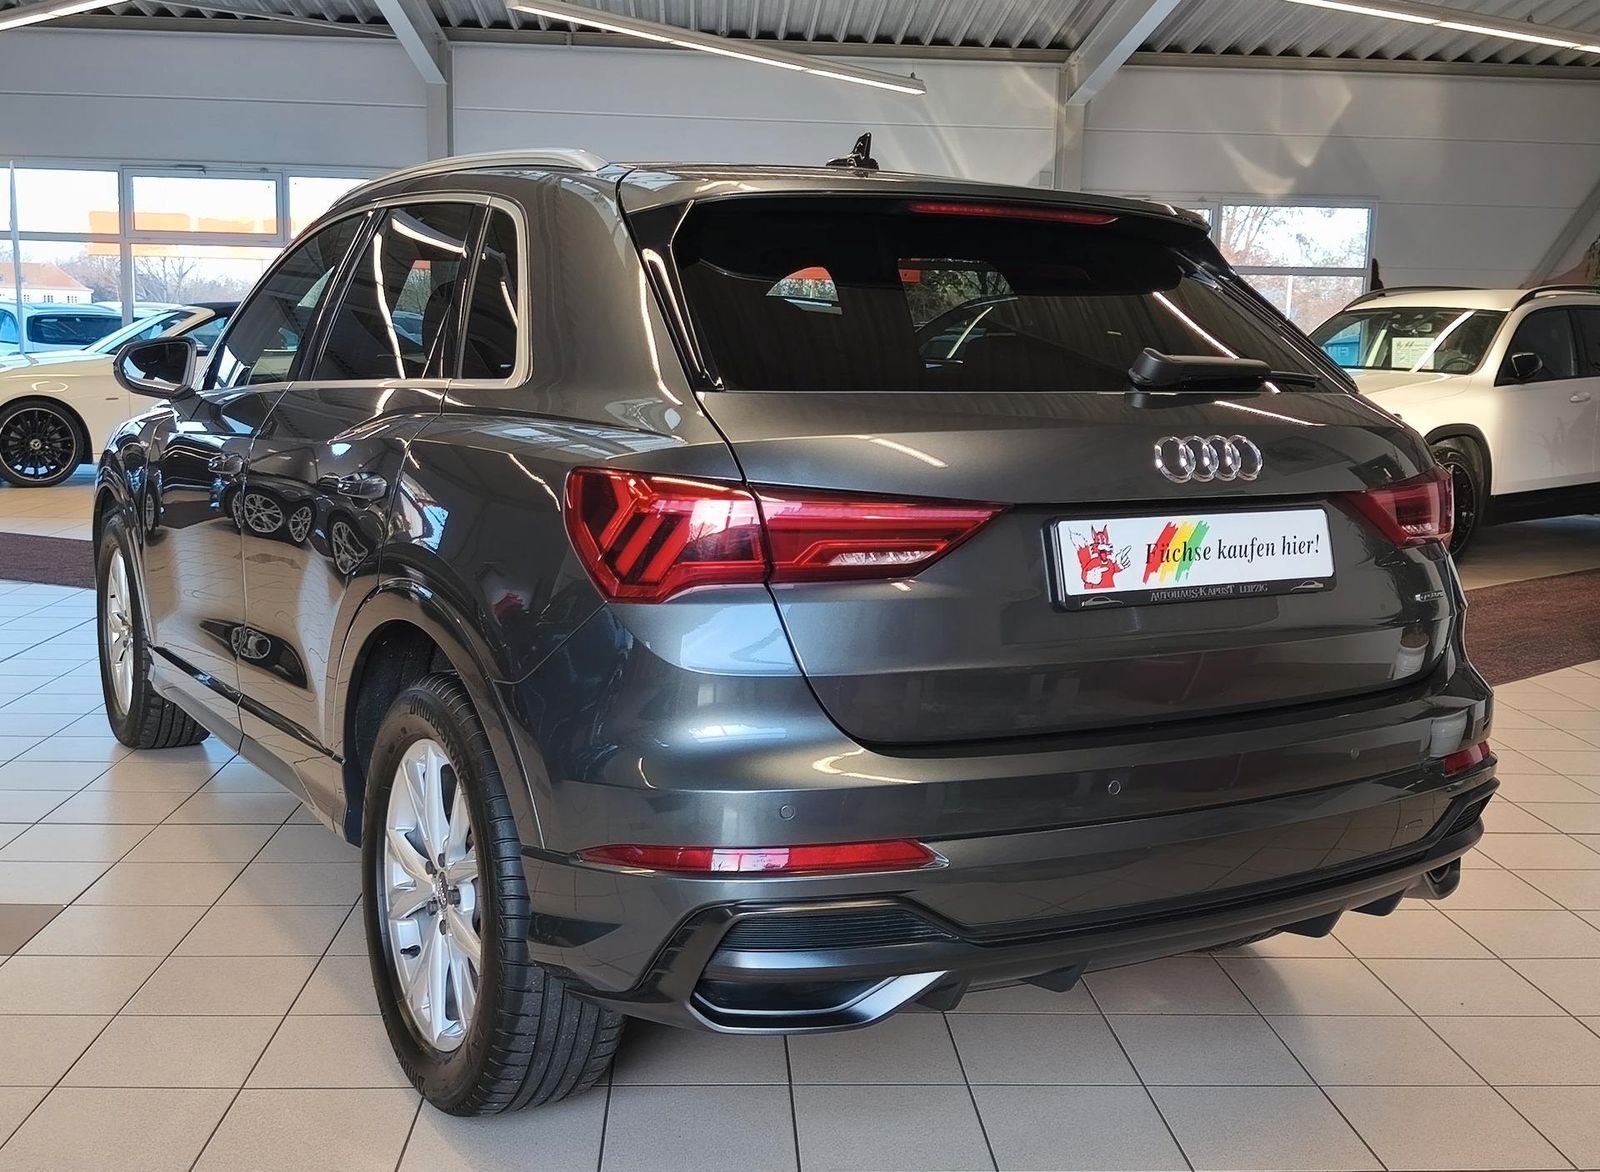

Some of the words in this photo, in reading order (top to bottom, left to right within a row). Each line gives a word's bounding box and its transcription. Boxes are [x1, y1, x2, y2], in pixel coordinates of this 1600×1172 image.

[1145, 541, 1211, 564] Füchse
[1217, 536, 1275, 563] kaufen
[1282, 533, 1319, 555] hier!
